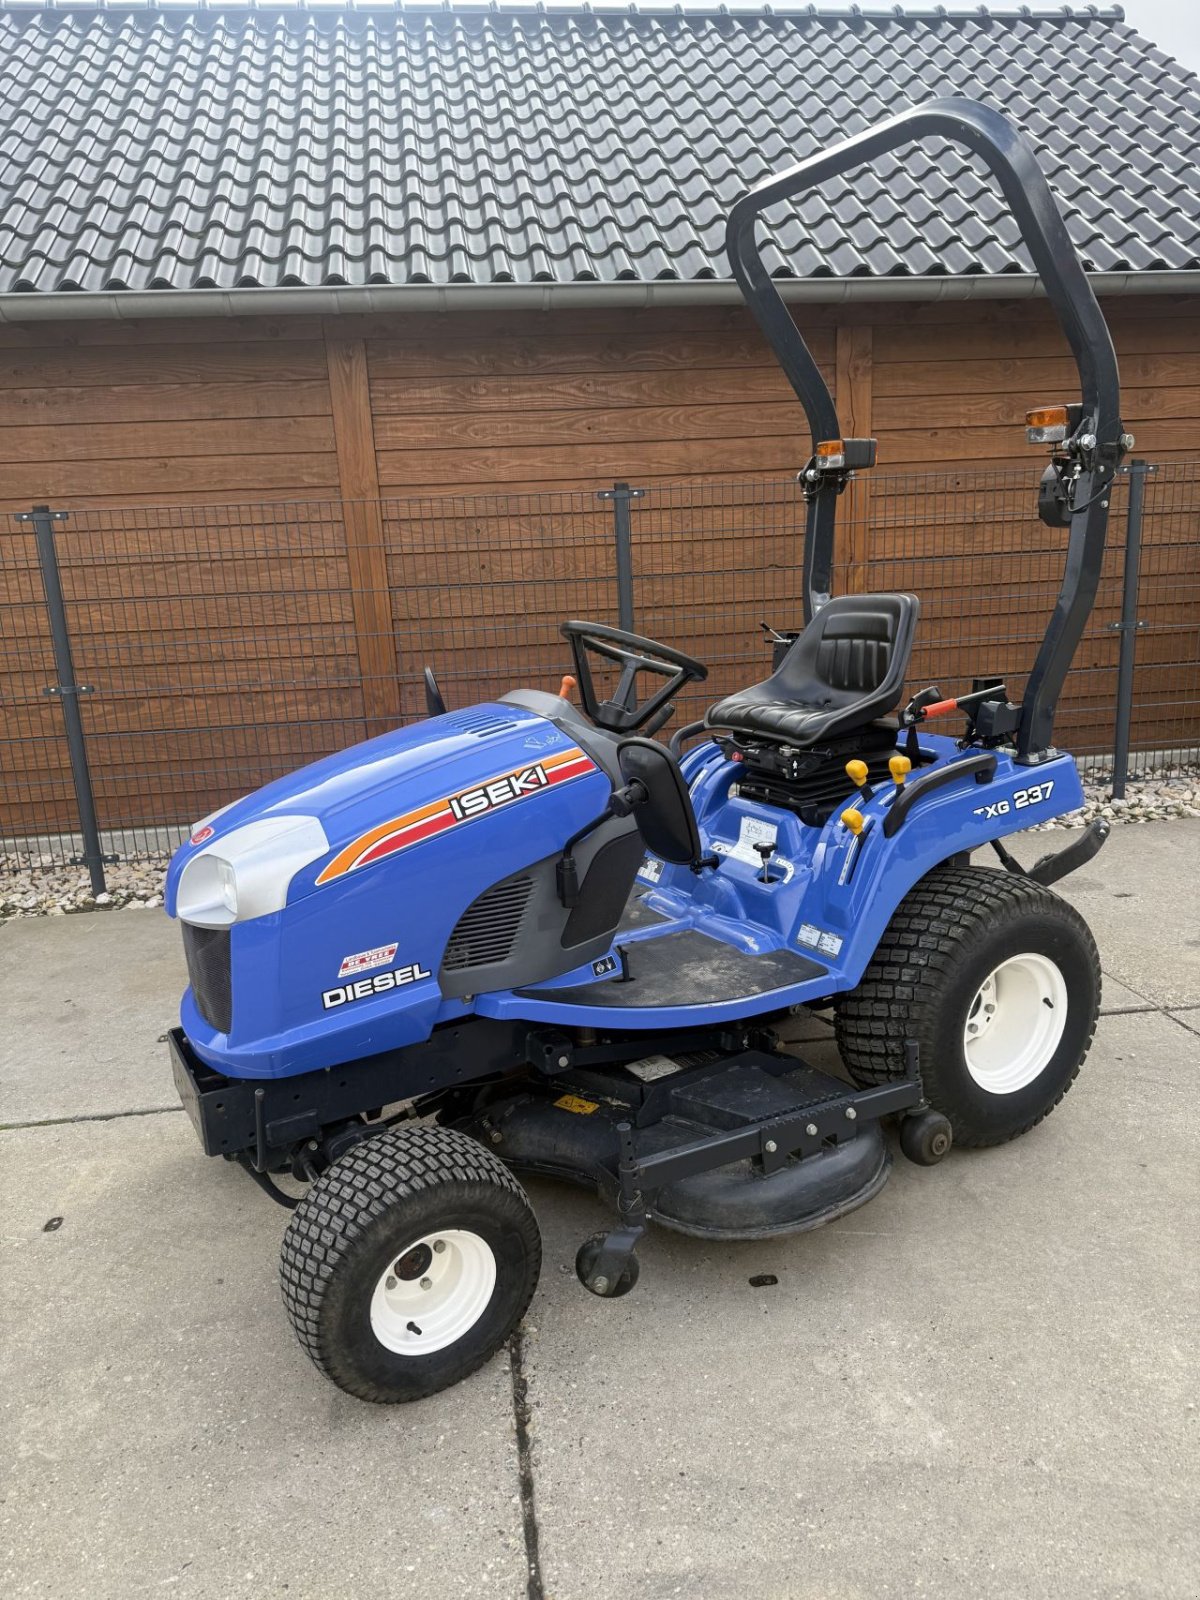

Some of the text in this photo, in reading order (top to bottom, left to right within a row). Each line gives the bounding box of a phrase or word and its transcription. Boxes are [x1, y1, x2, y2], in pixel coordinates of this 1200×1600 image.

[449, 765, 549, 820] ISEKI
[1013, 780, 1054, 809] 237
[322, 963, 432, 1010] DIESEL
